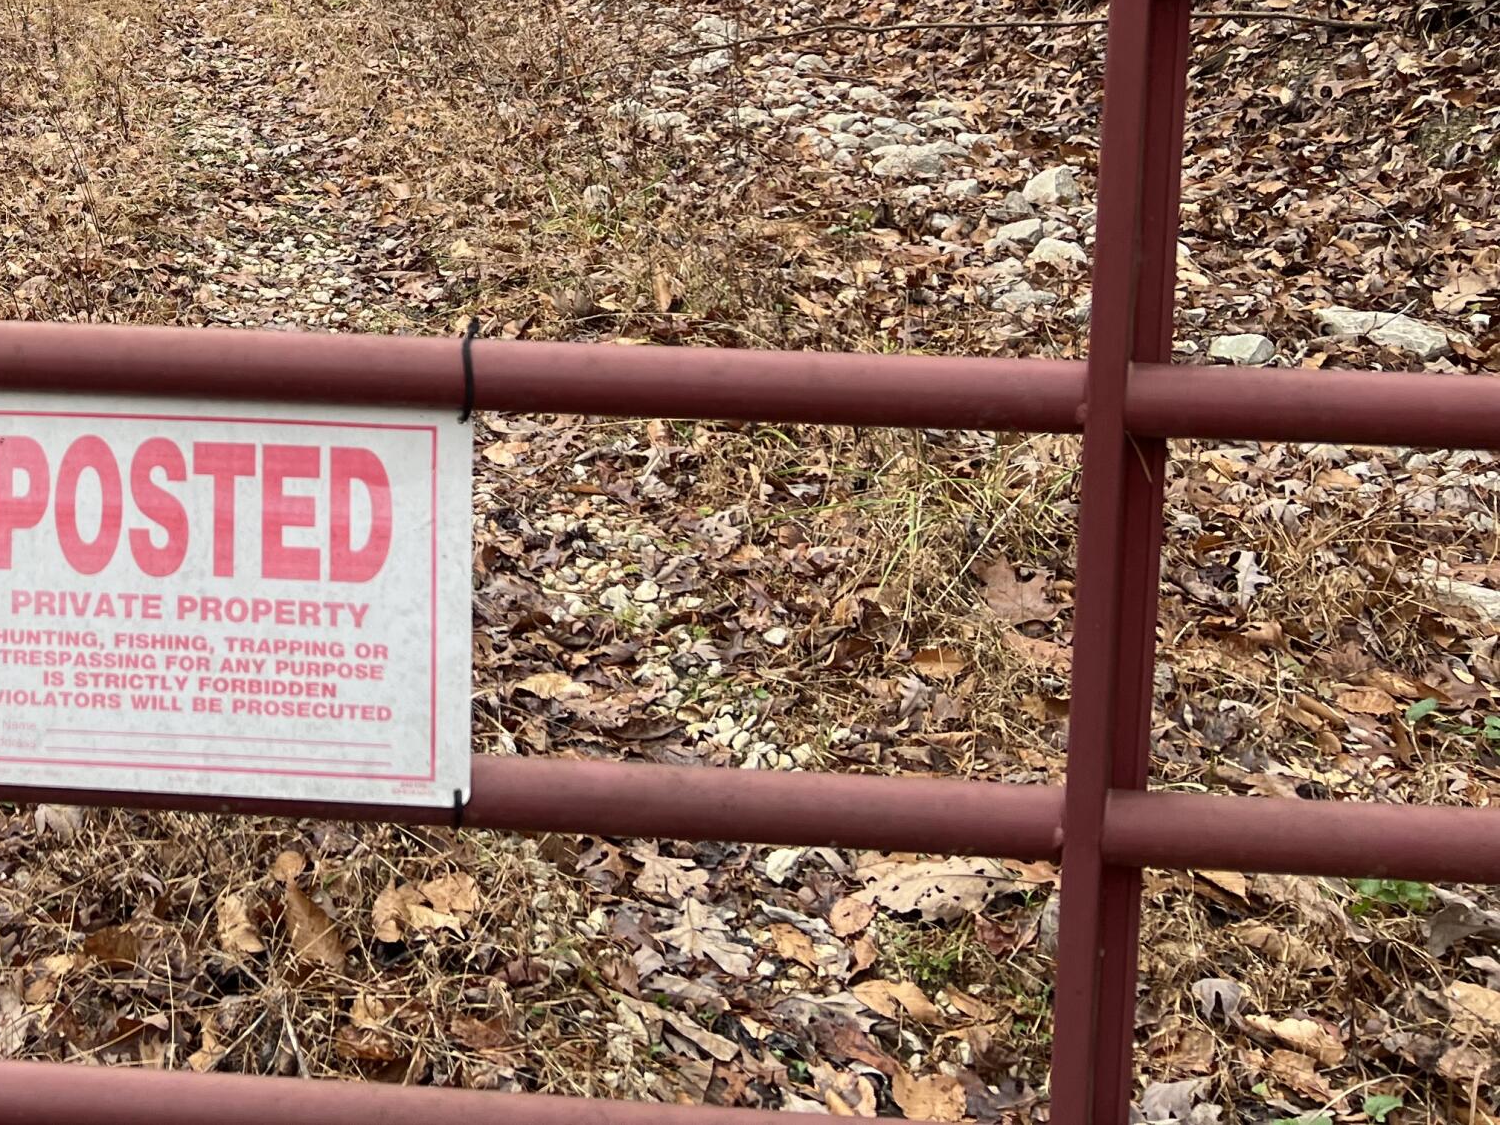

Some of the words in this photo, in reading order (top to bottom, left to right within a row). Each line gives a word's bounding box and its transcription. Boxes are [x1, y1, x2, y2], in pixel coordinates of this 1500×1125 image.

[11, 589, 163, 620] PRIVATE
[176, 595, 370, 628] PROPERTY
[114, 633, 215, 654] FISHING,
[224, 636, 345, 658] TRAPPING
[354, 643, 389, 660] OR
[0, 649, 156, 671] TRESPASSING
[165, 655, 211, 674] FOR
[220, 658, 266, 674] ANY
[275, 660, 385, 680] PURPOSE
[43, 671, 65, 687] IS
[74, 672, 189, 692] STRICTLY
[199, 677, 337, 698] FORBIDDEN
[131, 694, 182, 712] WILL
[192, 697, 223, 714] BE
[232, 698, 393, 722] PROSECUTED
[3, 720, 37, 731] Name
